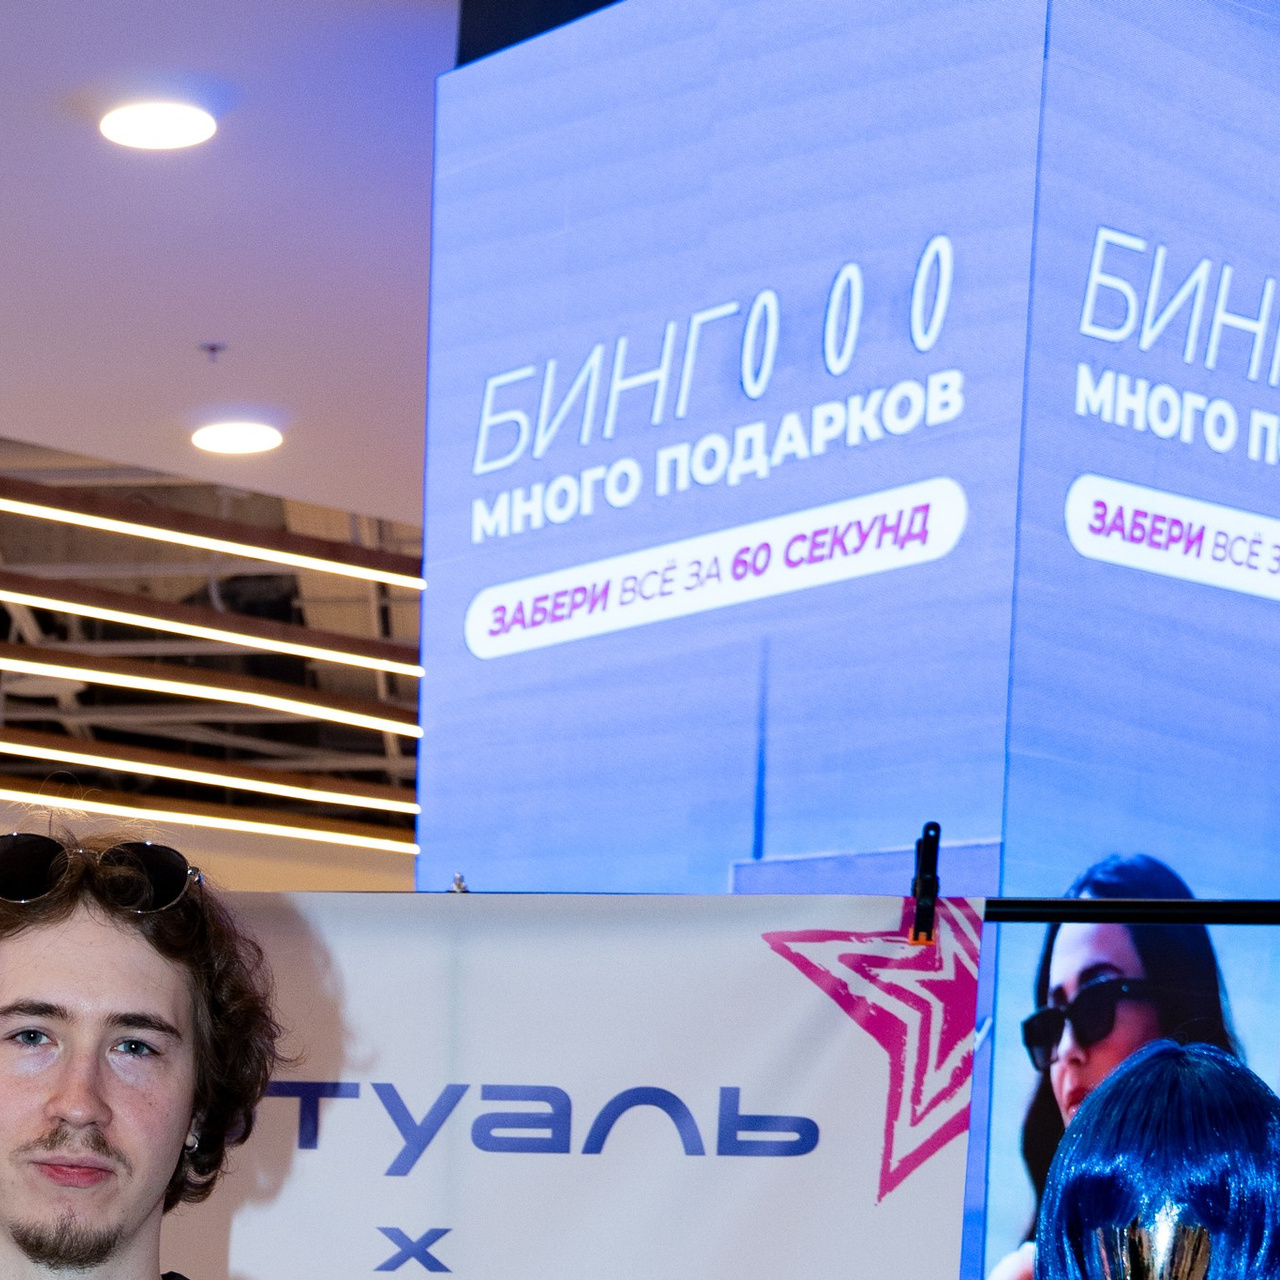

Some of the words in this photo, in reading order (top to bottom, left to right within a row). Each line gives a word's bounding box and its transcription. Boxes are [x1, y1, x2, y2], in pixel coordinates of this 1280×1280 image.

[1079, 226, 1280, 387] БИН
[471, 458, 641, 543] МНОГО
[655, 370, 964, 497] ПОДАРКОВ
[1075, 362, 1239, 453] МНОГО
[1247, 409, 1280, 466] П
[488, 581, 611, 637] ЗАБЕРИ
[618, 560, 677, 606] ВСЁ
[684, 556, 721, 591] ЗА
[731, 542, 772, 581] 60
[784, 504, 931, 569] СЕКУНД
[1088, 500, 1206, 558] ЗАБЕРИ
[1211, 530, 1263, 571] ВСЁ
